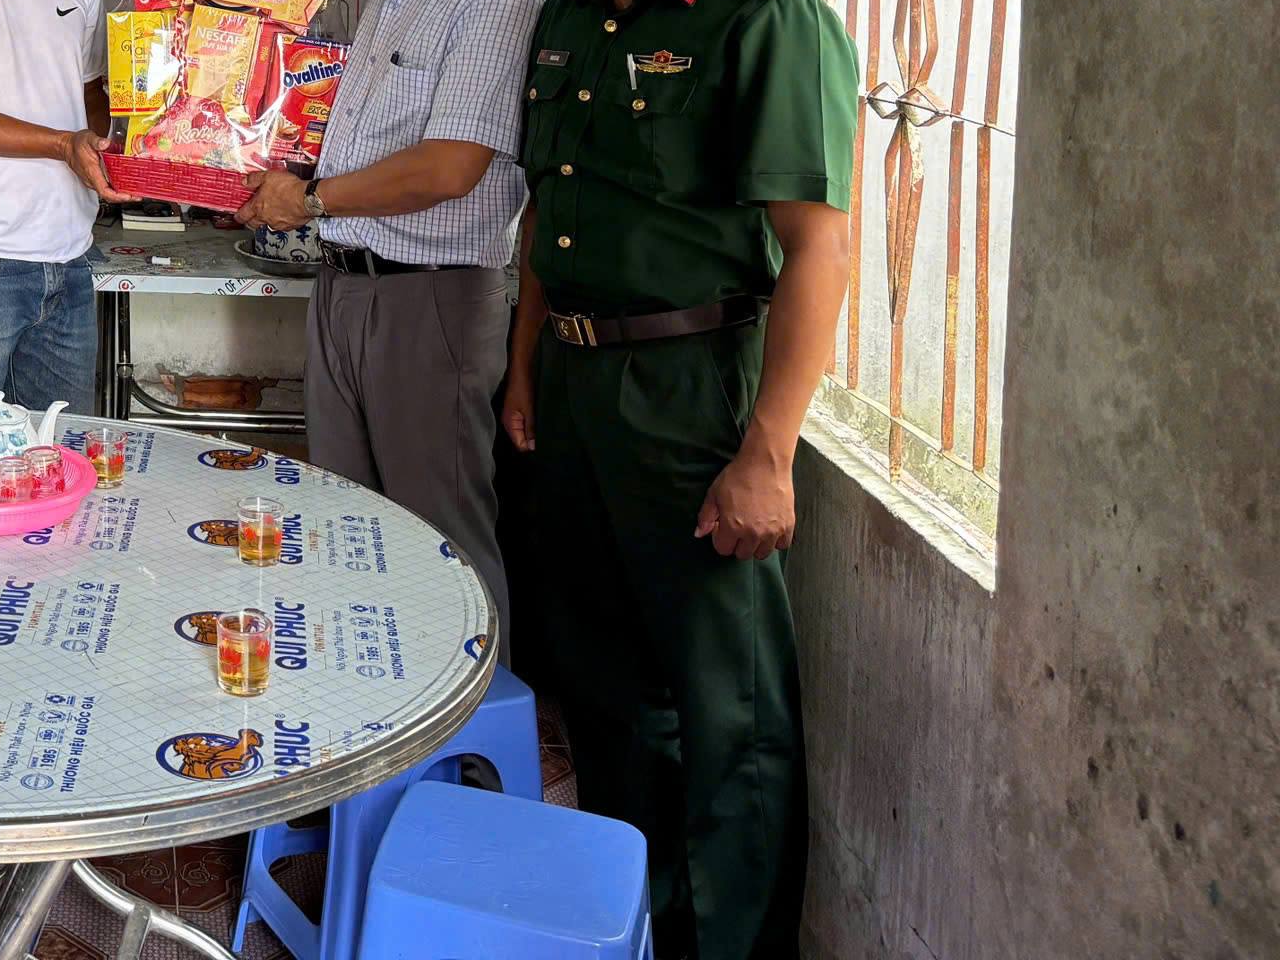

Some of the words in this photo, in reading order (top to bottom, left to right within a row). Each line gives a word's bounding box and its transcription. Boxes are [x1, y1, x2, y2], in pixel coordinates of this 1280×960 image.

[284, 62, 342, 87] Ovaltine
[274, 601, 306, 639] PHUC
[274, 640, 307, 670] QUI
[81, 696, 95, 709] GIA
[73, 711, 91, 735] QUỐC
[40, 749, 57, 767] 1985
